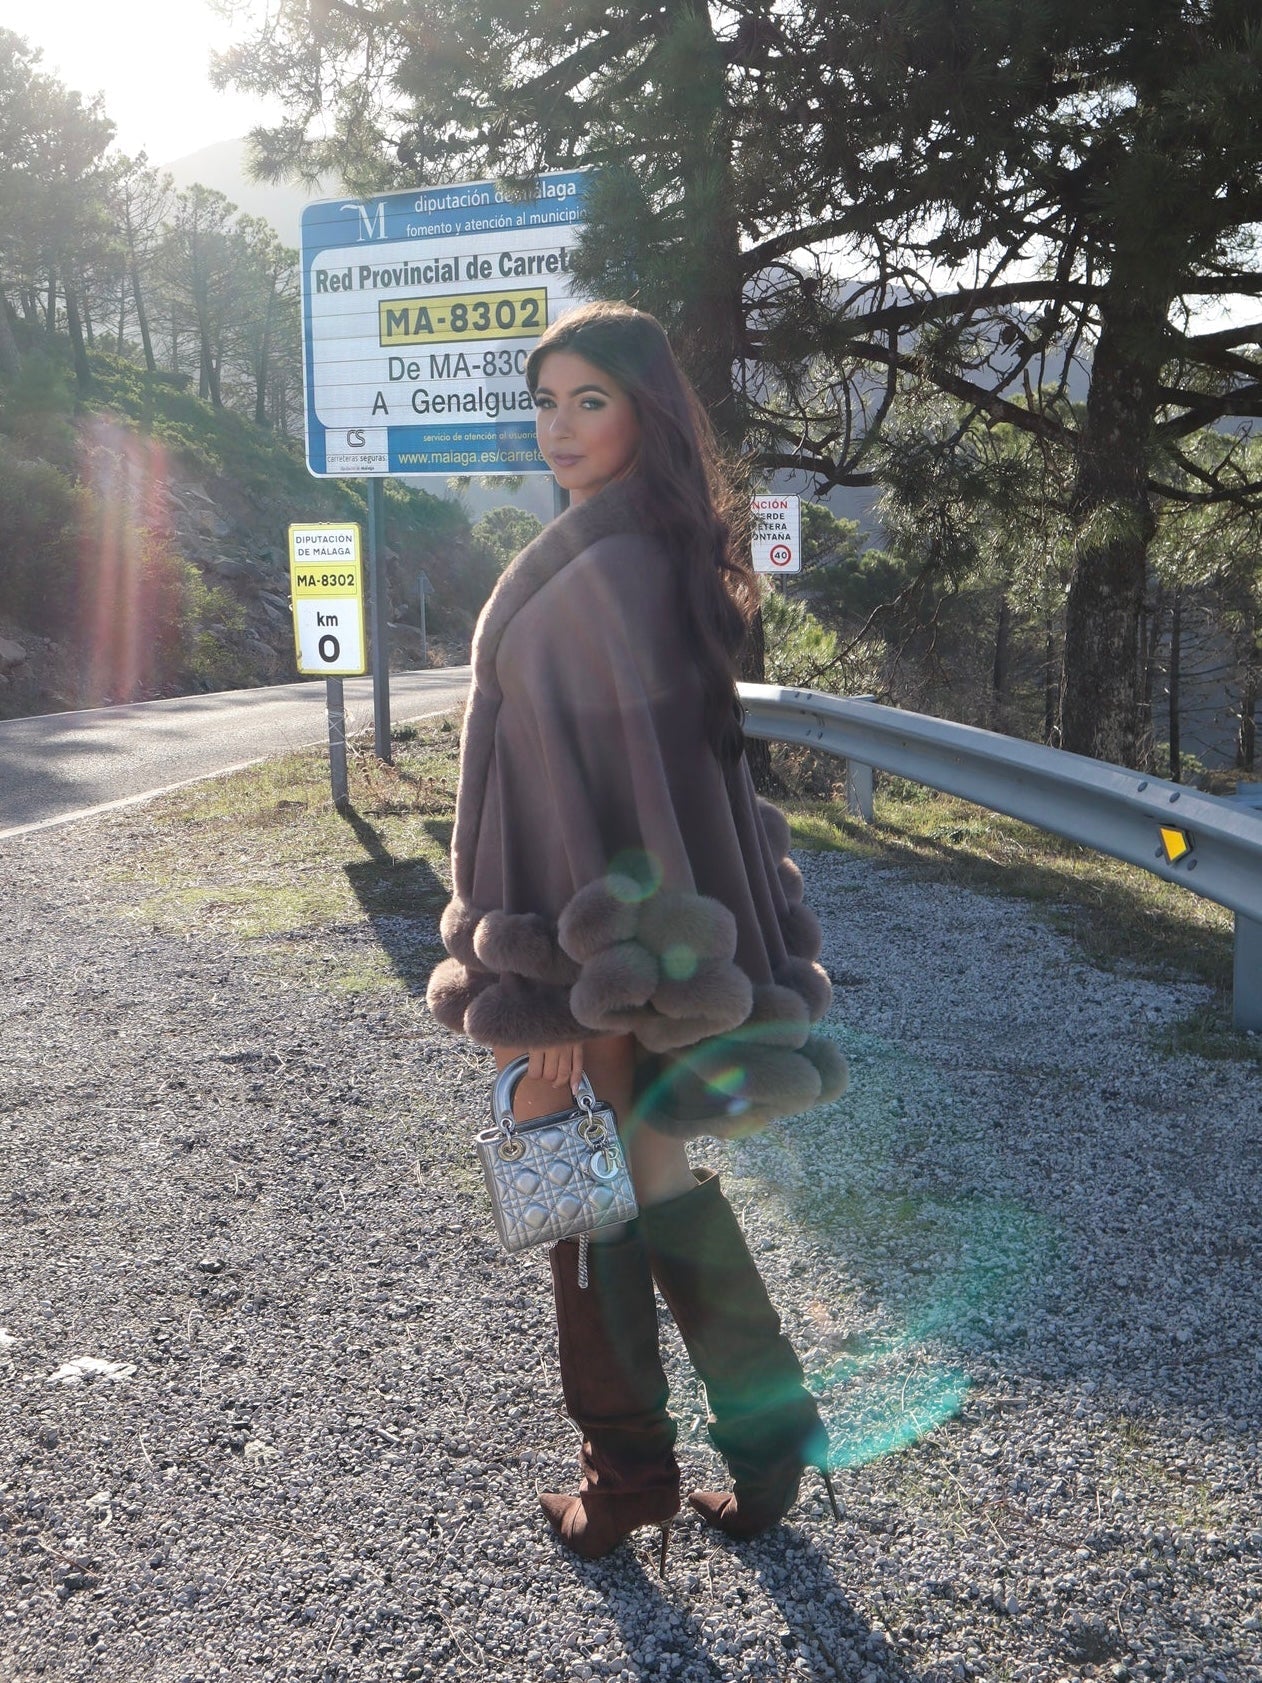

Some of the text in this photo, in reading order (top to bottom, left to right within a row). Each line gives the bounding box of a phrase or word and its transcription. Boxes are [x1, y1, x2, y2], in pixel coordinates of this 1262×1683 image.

[414, 189, 490, 215] diputación
[406, 224, 452, 238] fomento
[455, 222, 462, 236] y
[464, 214, 513, 231] atención
[516, 211, 526, 226] al
[316, 267, 352, 293] Red
[359, 257, 459, 289] Provincial
[466, 254, 493, 280] de
[386, 297, 540, 337] MA-8302
[388, 356, 421, 381] De
[372, 386, 534, 418] A Genalgua
[423, 432, 450, 442] servicio
[452, 431, 463, 441] de
[464, 430, 497, 441] atención
[360, 455, 386, 464] seguras
[298, 548, 310, 556] DE
[774, 551, 788, 559] 40
[297, 574, 355, 587] MA-8302
[317, 611, 339, 627] km
